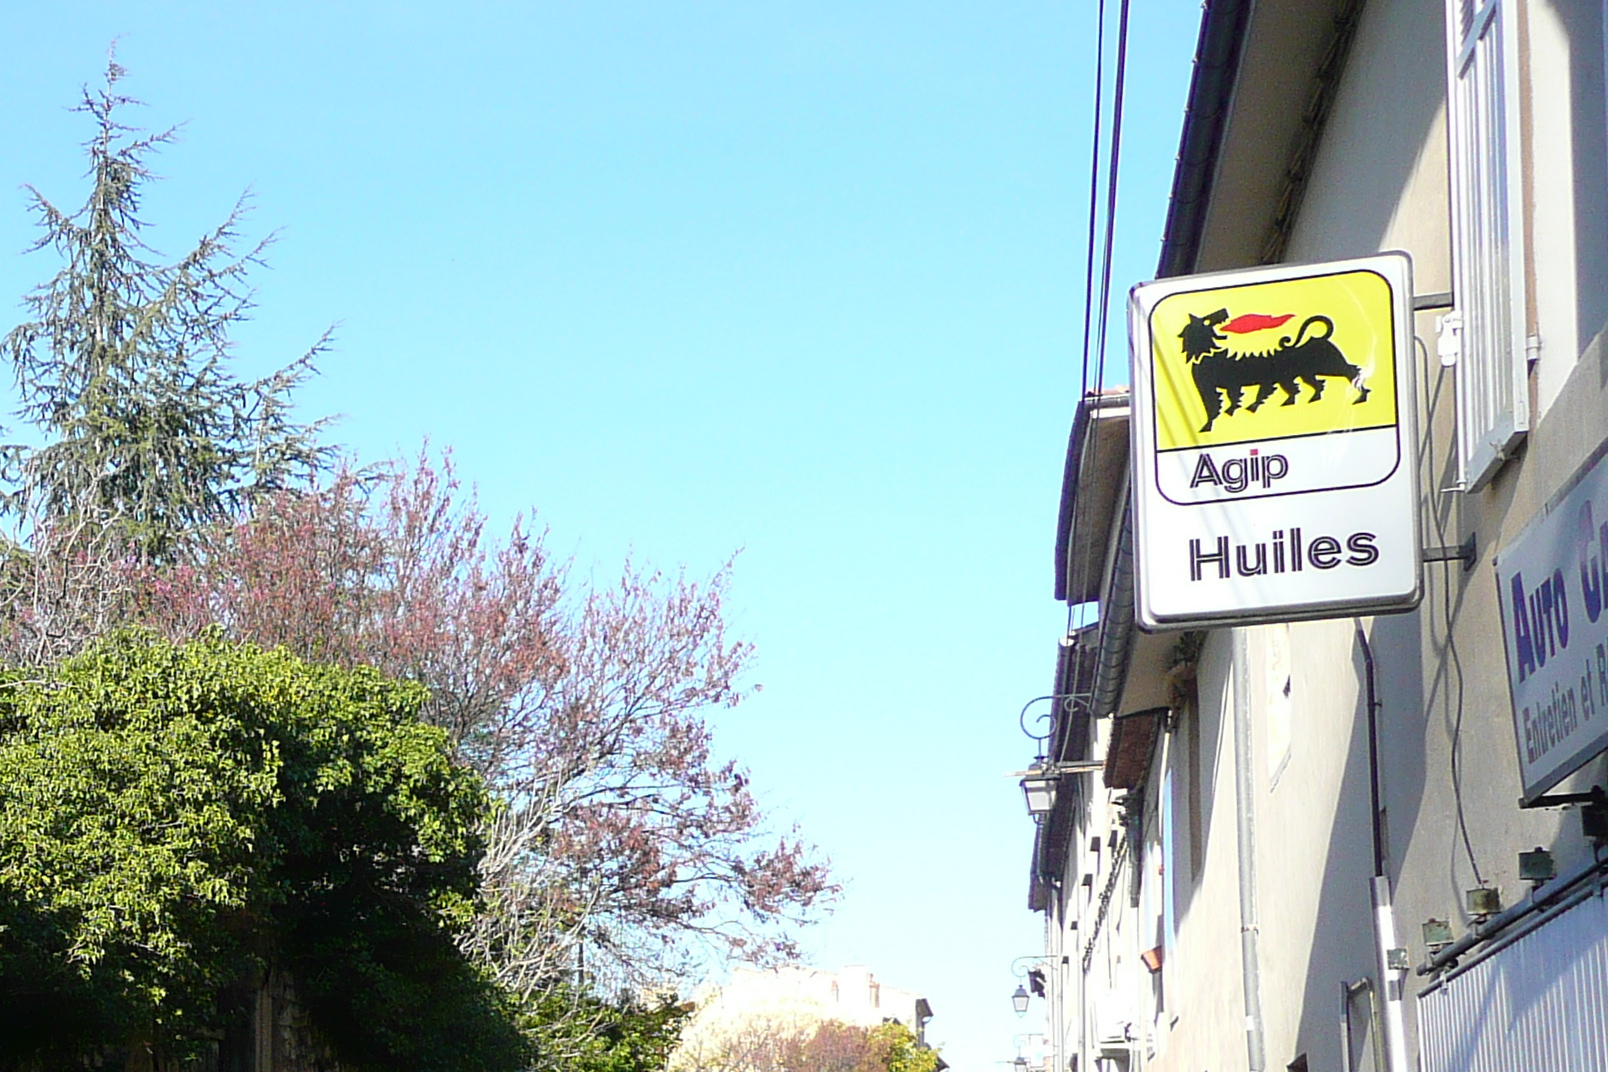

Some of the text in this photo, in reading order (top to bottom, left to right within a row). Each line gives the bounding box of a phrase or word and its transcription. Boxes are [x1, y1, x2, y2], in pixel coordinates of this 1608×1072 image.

[1189, 448, 1289, 493] Agip
[1189, 527, 1379, 582] Huiles
[1521, 680, 1578, 765] Entretien
[1580, 658, 1596, 722] et
